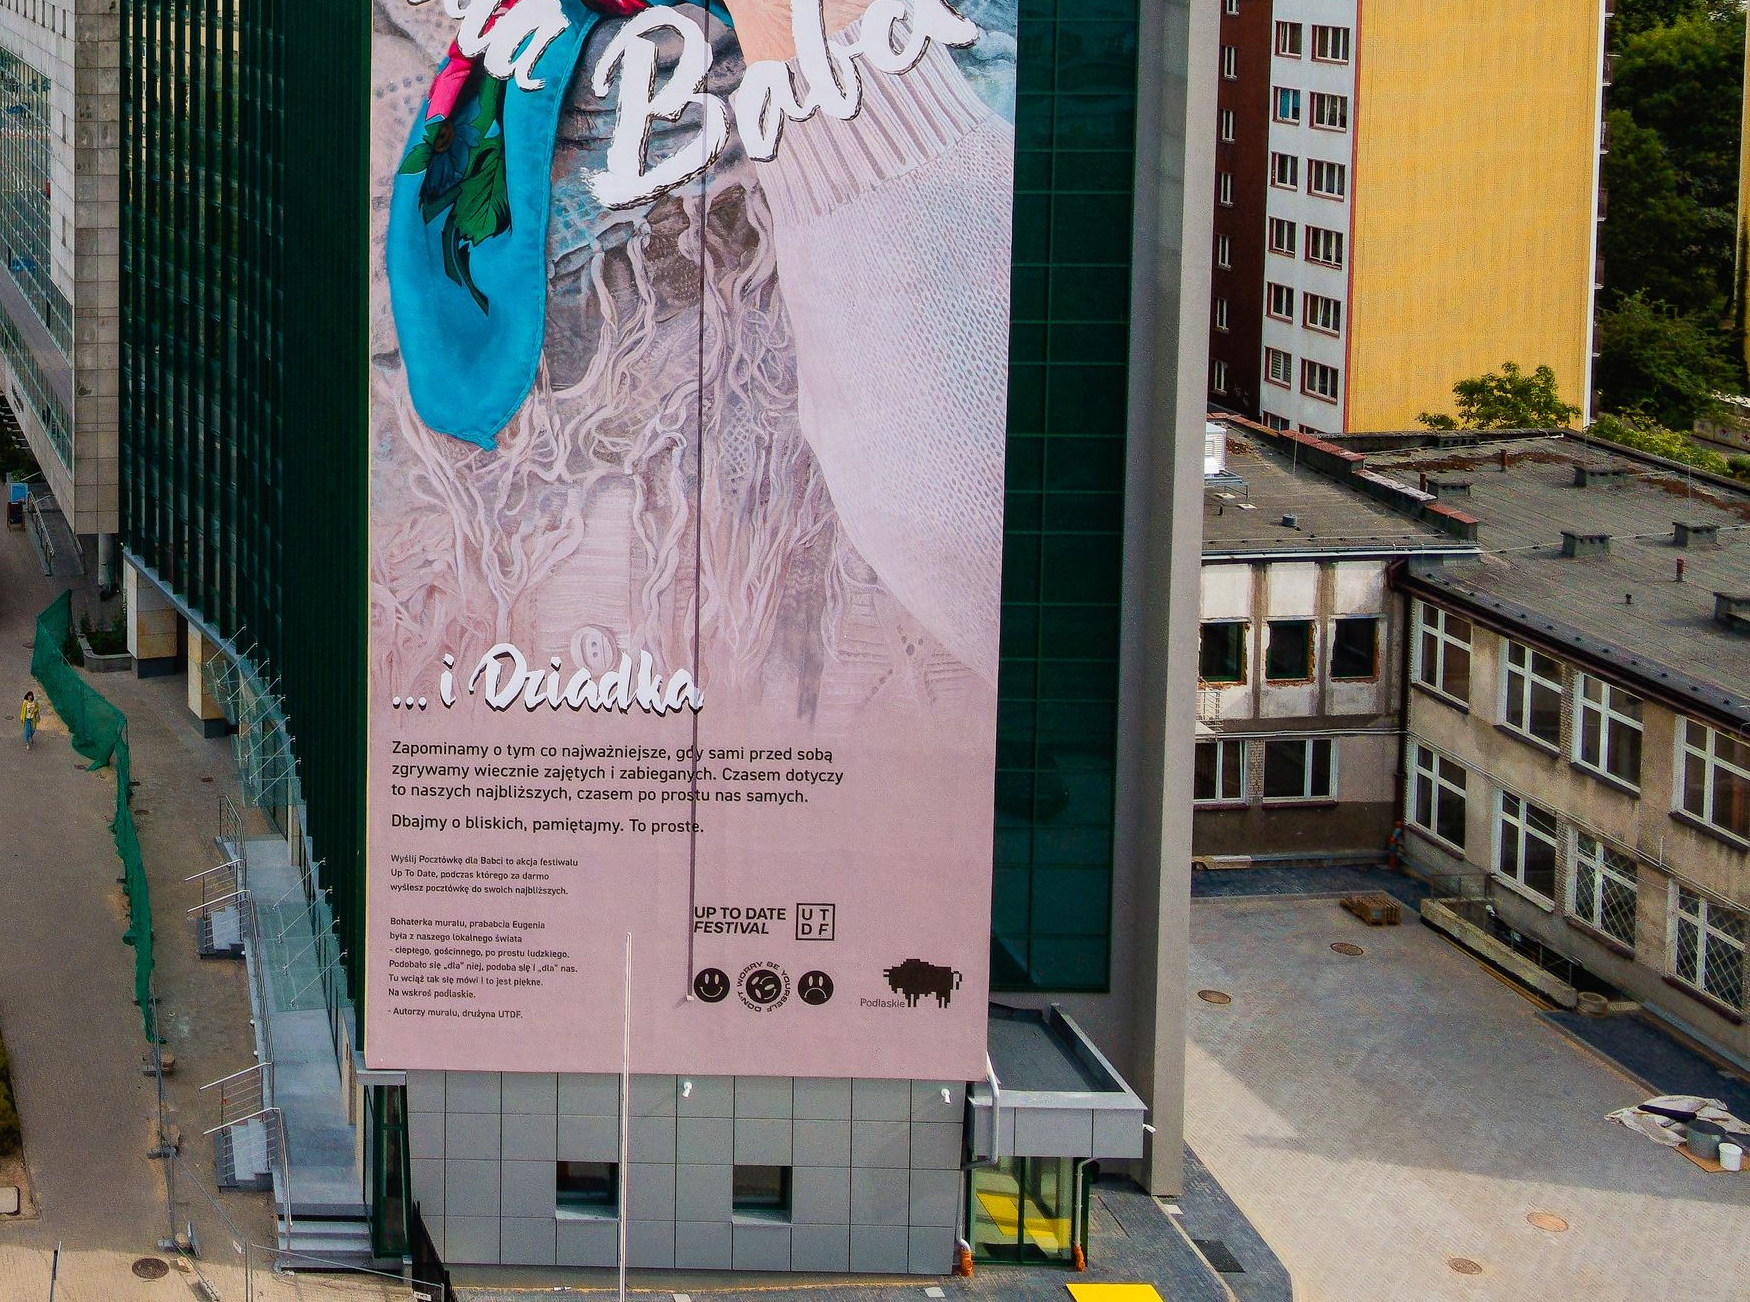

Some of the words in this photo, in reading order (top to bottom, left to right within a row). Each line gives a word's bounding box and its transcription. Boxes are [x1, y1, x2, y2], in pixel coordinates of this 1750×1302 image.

[468, 642, 705, 716] Dziadka
[392, 740, 489, 758] Zapominamy
[493, 745, 502, 756] o
[507, 744, 535, 760] tym
[540, 746, 557, 757] co
[562, 745, 671, 761] najważniejsze,
[676, 746, 703, 762] gdy
[708, 747, 744, 760] sami
[749, 747, 792, 762] przed
[797, 748, 833, 763] sobą
[392, 764, 470, 779] zgrywamy
[474, 764, 539, 778] wiecznie
[544, 765, 606, 781] zajętych
[620, 767, 717, 783] zabieganych.
[722, 768, 781, 781] Czasem
[786, 769, 844, 785] dotyczy
[392, 784, 406, 796] to
[411, 784, 471, 800] naszych
[476, 785, 572, 802] najbliższych,
[577, 788, 633, 800] czasem
[638, 790, 656, 803] po
[661, 789, 710, 803] prostu
[715, 791, 741, 802] nas
[746, 789, 808, 805] samych.
[391, 814, 447, 831] Dbajmy
[452, 818, 461, 829] o
[465, 816, 527, 832] bliskich,
[533, 817, 624, 834] pamiętajmy.
[629, 819, 646, 832] To
[651, 821, 704, 835] proste.
[391, 854, 417, 864] Wyślij
[419, 855, 463, 865] Pocztówkę
[465, 857, 478, 865] dla
[480, 857, 503, 865] Babci
[516, 858, 538, 867] akcja
[540, 858, 578, 867] festiwalu
[391, 869, 403, 878] Up
[417, 870, 438, 878] Date,
[441, 871, 474, 879] podczas
[476, 871, 508, 880] którego
[522, 872, 549, 880] darmo
[390, 883, 423, 893] wyślesz
[426, 884, 469, 894] pocztówkę
[472, 885, 481, 893] do
[484, 885, 513, 894] swoich
[515, 886, 568, 895] najbliższych.
[694, 907, 717, 919] UP
[720, 907, 741, 919] TO
[746, 908, 786, 920] DATE
[390, 918, 432, 926] Bohaterka
[435, 919, 467, 928] muralu,
[469, 920, 510, 929] prababcia
[512, 920, 545, 930] Eugenia
[694, 921, 769, 935] FESTIVAL
[389, 932, 407, 941] była
[416, 933, 450, 942] naszego
[452, 933, 493, 943] lokalnego
[495, 933, 522, 943] świata
[485, 950, 495, 958] po
[498, 949, 525, 958] prostu
[389, 960, 427, 969] Podobało
[429, 961, 442, 970] się
[486, 963, 516, 972] podoba
[766, 961, 780, 970] BE
[389, 974, 399, 982] Tu
[401, 975, 425, 984] wciąż
[456, 976, 478, 984] mówi
[486, 977, 494, 985] to
[496, 977, 512, 986] jest
[736, 961, 763, 987] WORRY
[389, 988, 399, 996] Na
[401, 988, 431, 997] wskroś
[766, 970, 791, 1013] YOURSELF
[860, 998, 905, 1008] Podlaskie
[393, 1007, 425, 1017] Autorzy
[427, 1009, 460, 1018] muralu,
[462, 1009, 495, 1018] drużyna
